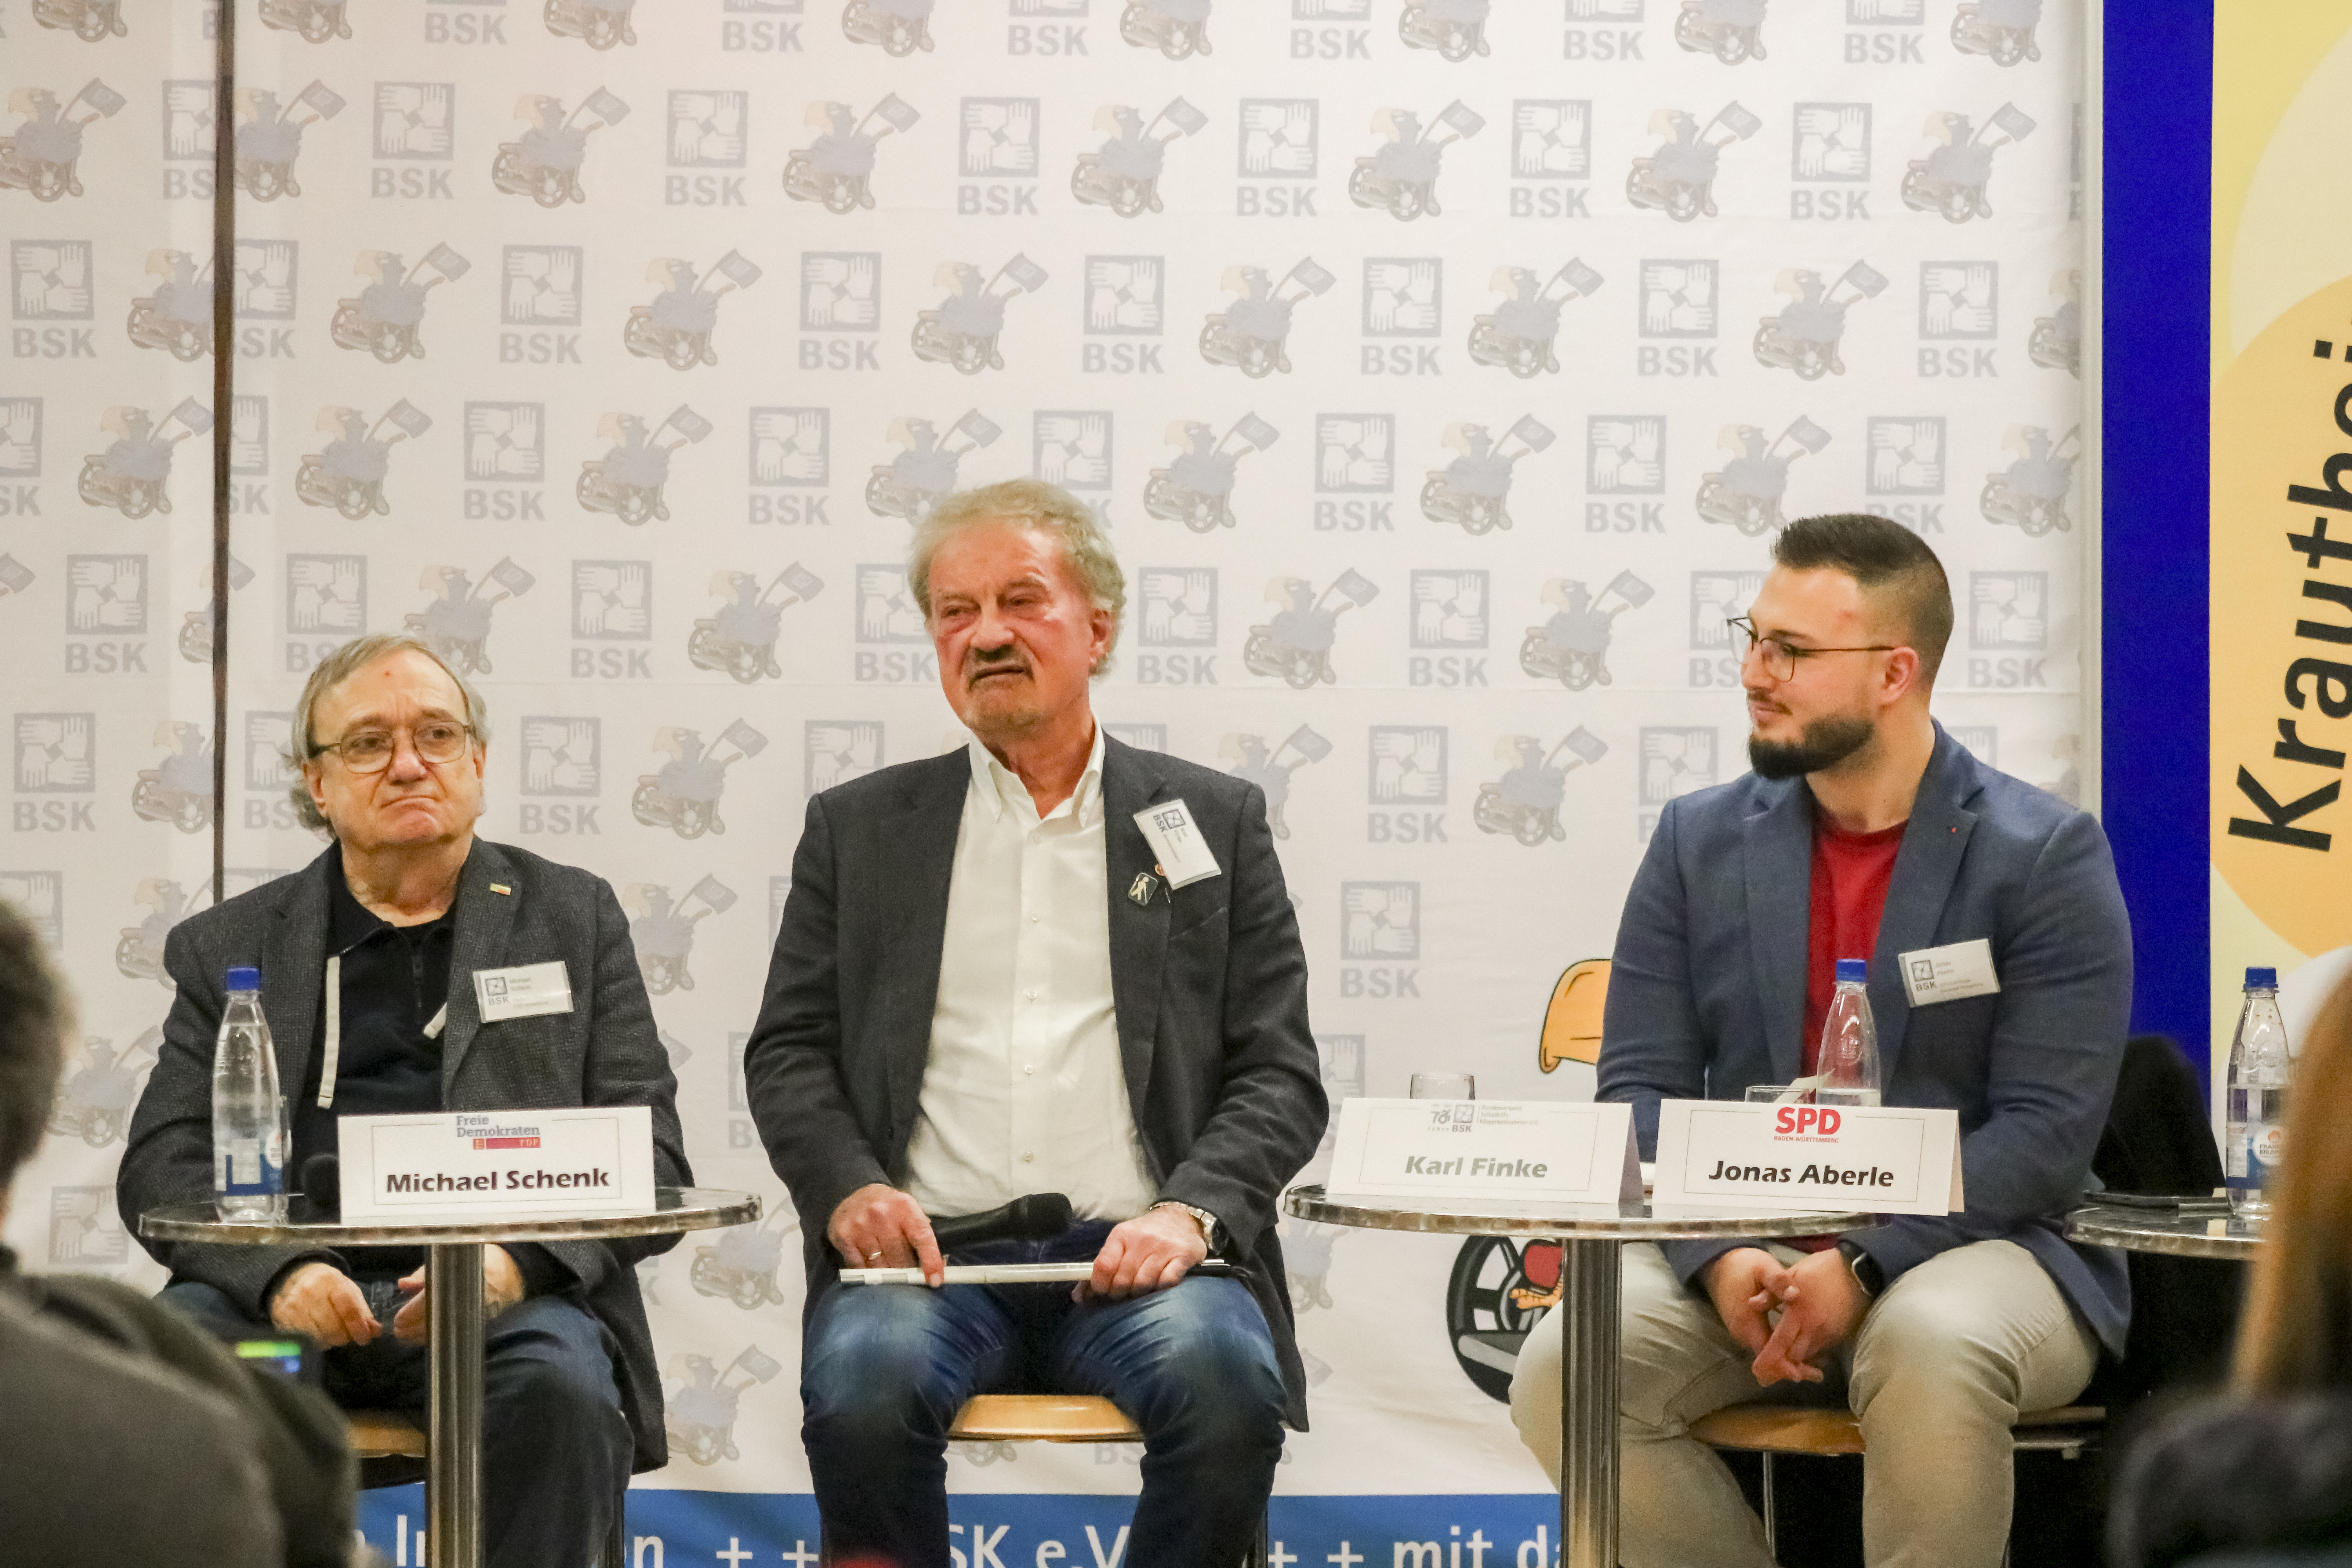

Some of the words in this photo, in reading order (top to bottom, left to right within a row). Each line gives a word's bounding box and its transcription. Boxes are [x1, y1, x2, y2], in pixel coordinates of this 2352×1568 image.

[424, 12, 506, 45] BSK
[722, 20, 803, 53] BSK
[1007, 25, 1088, 56] BSK
[1290, 29, 1370, 60] BSK
[1563, 30, 1644, 61] BSK
[1844, 33, 1924, 64] BSK
[163, 169, 216, 200] BS
[371, 167, 453, 200] BSK
[664, 174, 746, 207] BSK
[956, 185, 1038, 216] BSK
[1236, 186, 1318, 218] BSK
[1510, 187, 1591, 219] BSK
[1790, 190, 1871, 221] BSK
[12, 328, 96, 359] BSK
[241, 327, 296, 359] SK
[499, 332, 582, 365] BSK
[799, 339, 880, 371] BSK
[1082, 343, 1163, 374] BSK
[1361, 345, 1441, 376] BSK
[1637, 347, 1718, 377] BSK
[1918, 348, 1998, 378] BSK
[463, 489, 544, 521] BSK
[748, 494, 830, 526] BSK
[1314, 501, 1394, 532] BSK
[1585, 502, 1666, 534] BSK
[65, 642, 147, 674] BSK
[570, 648, 652, 679] BSK
[855, 651, 937, 682] BSK
[1137, 655, 1217, 686] BSK
[1409, 657, 1488, 688] BSK
[1690, 658, 1741, 688] BS
[1967, 657, 2047, 688] BSK
[13, 801, 96, 833] BSK
[245, 800, 295, 830] BS
[519, 804, 601, 836] BSK
[1153, 814, 1168, 833] BSK
[1367, 812, 1448, 844] BSK
[1340, 968, 1421, 999] BSK
[1915, 980, 1937, 992] BSK
[456, 1115, 490, 1126] Freie
[457, 1125, 541, 1137] Demokraten
[1452, 1124, 1472, 1132] BSK
[1775, 1107, 1841, 1135] SPD
[387, 1172, 497, 1193] Michael
[506, 1168, 610, 1190] Schenk
[1405, 1156, 1464, 1176] Karl
[1470, 1158, 1548, 1178] Finke
[1709, 1161, 1791, 1183] Jonas
[1798, 1165, 1894, 1187] Aberle
[1394, 1525, 1493, 1568] mit
